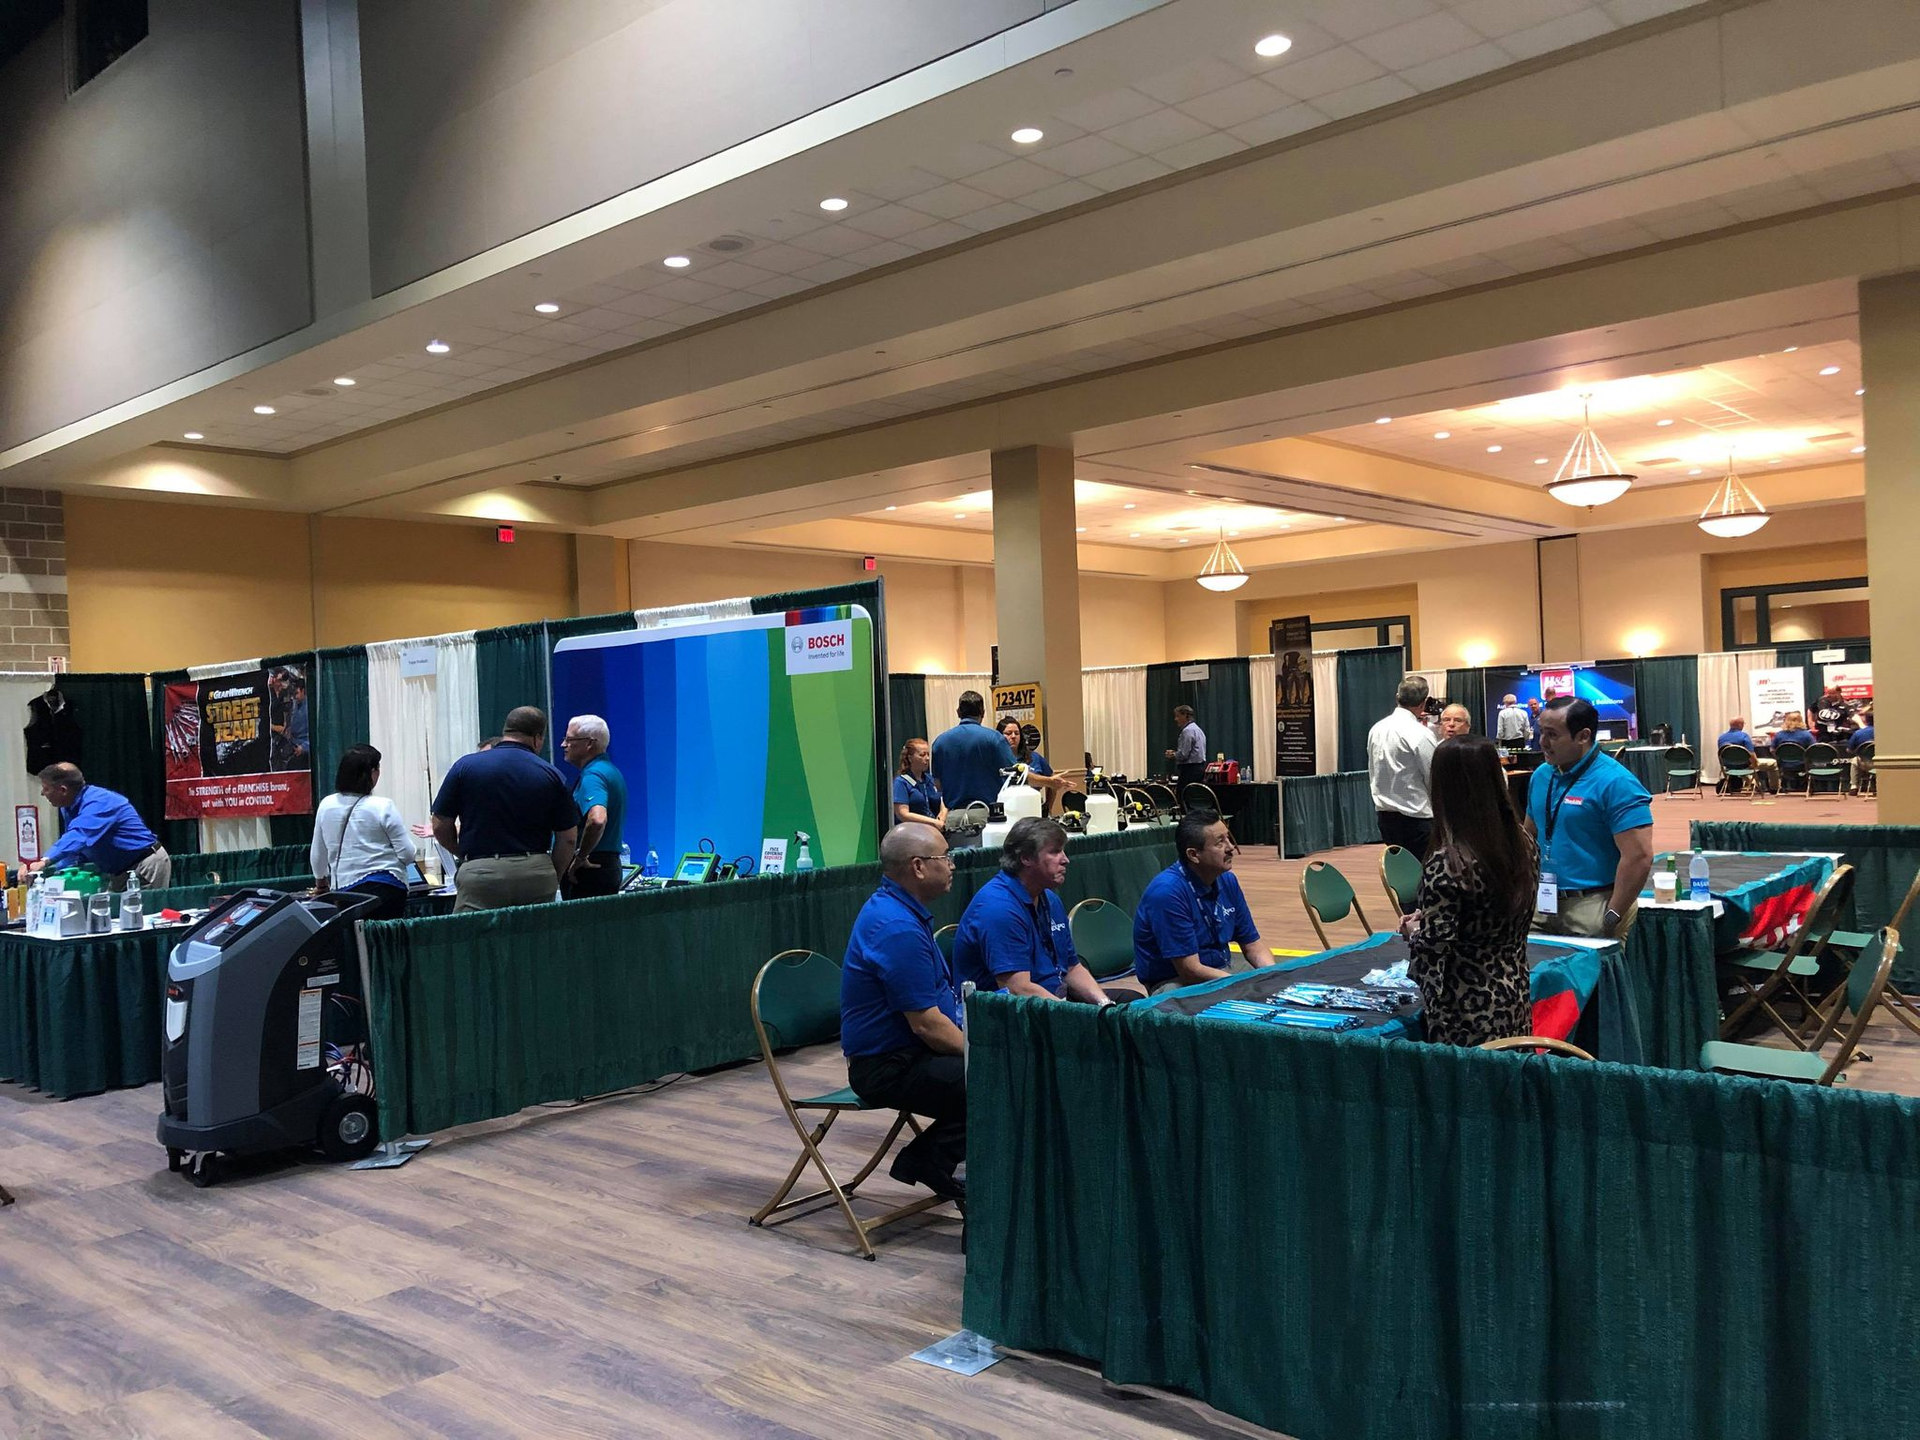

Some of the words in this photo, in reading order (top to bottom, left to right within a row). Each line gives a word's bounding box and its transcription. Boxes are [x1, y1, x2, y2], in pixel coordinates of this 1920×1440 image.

[808, 634, 845, 649] BOSCH
[808, 652, 829, 660] Invented
[996, 689, 1036, 708] 1234YF
[206, 697, 261, 724] STREET
[213, 719, 256, 743] TEAM
[225, 784, 232, 794] of
[237, 783, 270, 794] FRANCHISE
[225, 797, 238, 807] YOU
[238, 797, 244, 806] in
[245, 795, 274, 806] CONTROL
